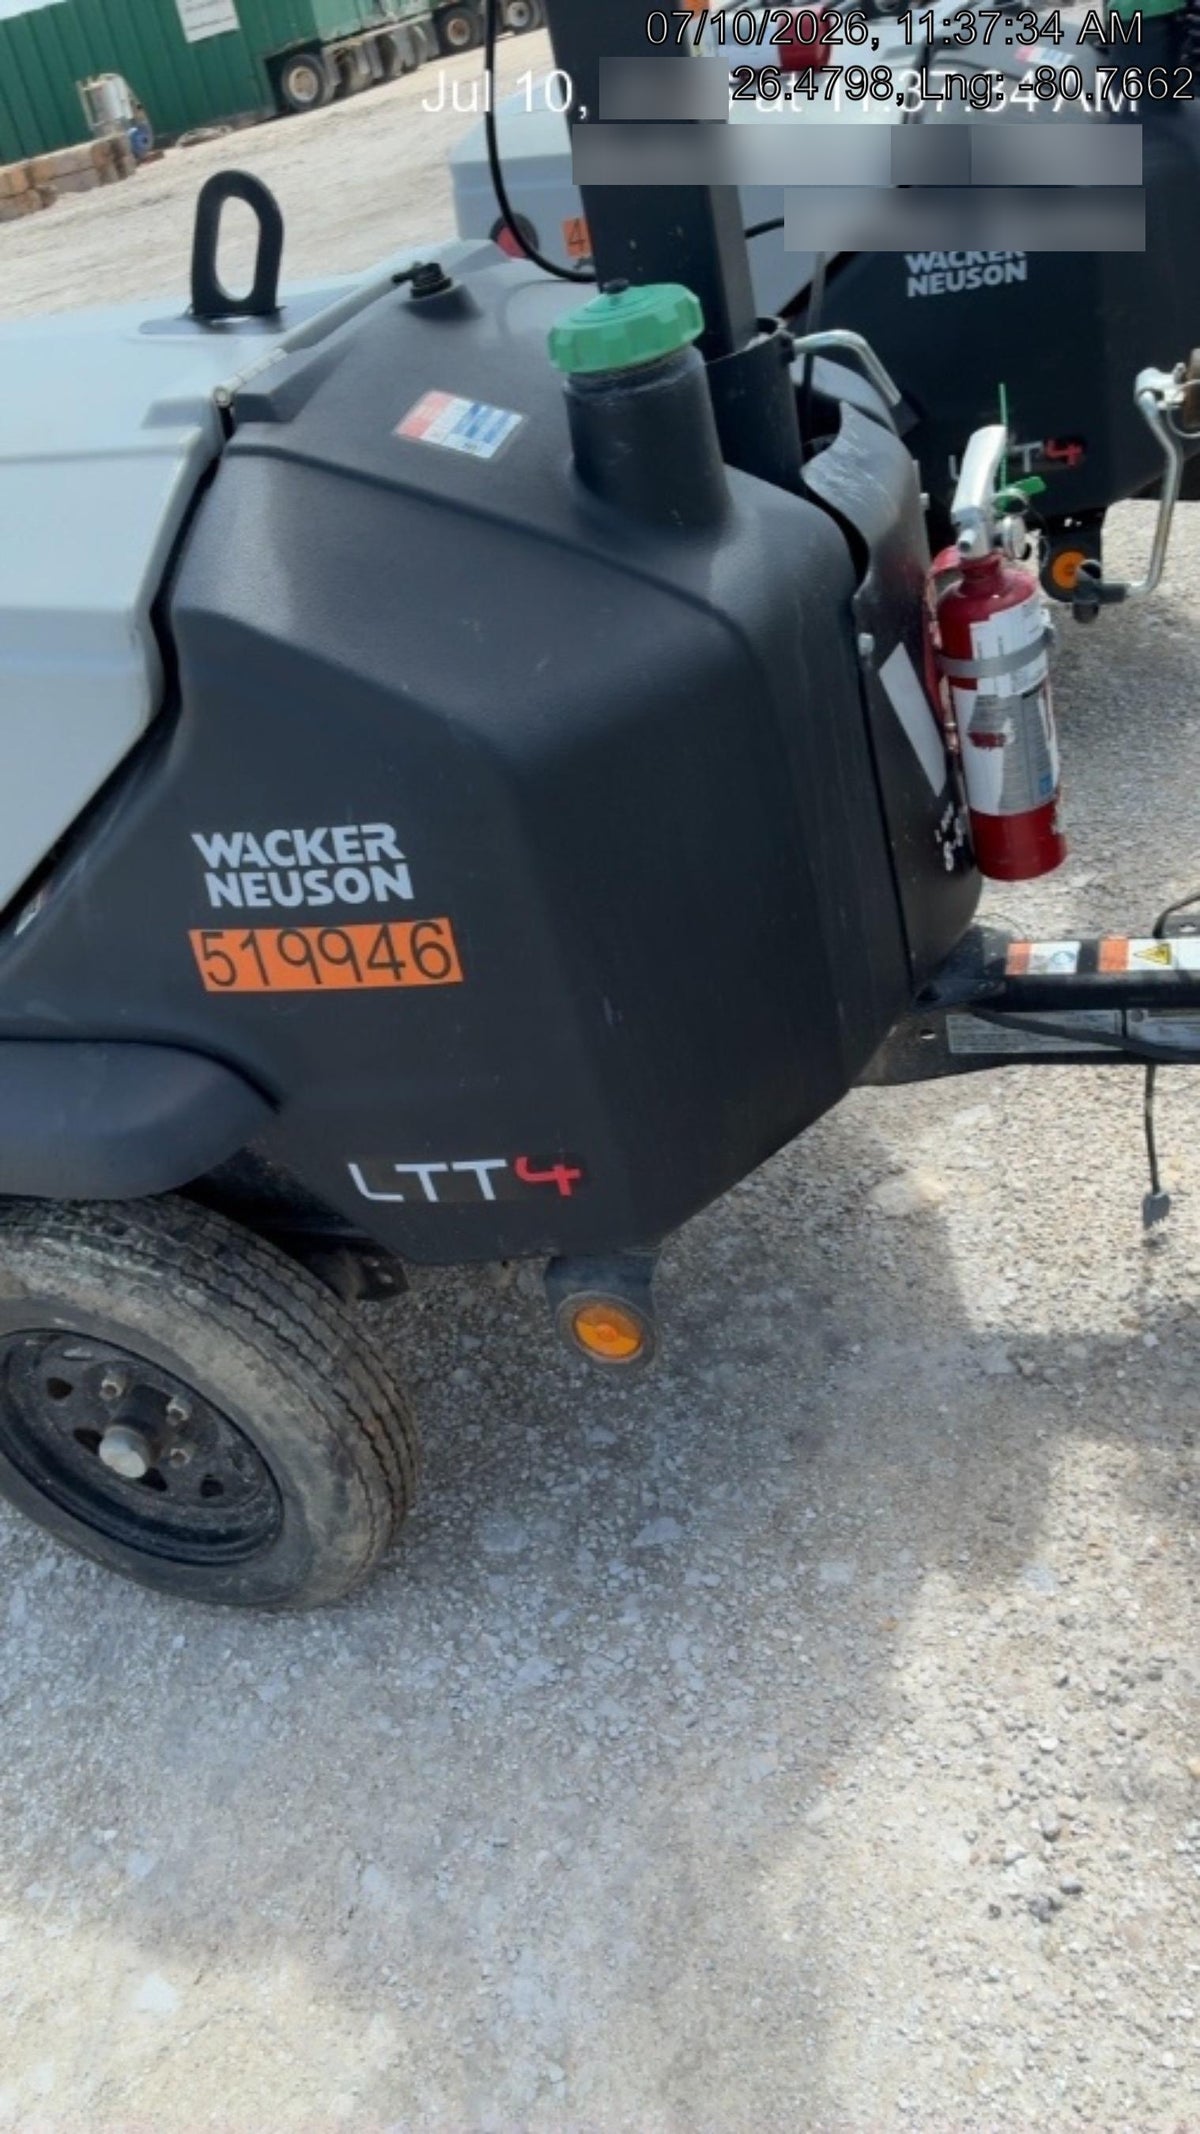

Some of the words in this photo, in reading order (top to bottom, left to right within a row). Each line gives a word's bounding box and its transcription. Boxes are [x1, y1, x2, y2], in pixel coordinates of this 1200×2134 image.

[907, 259, 1028, 298] NEUSON
[948, 437, 1084, 482] LT4
[190, 822, 406, 868] WACKER
[203, 862, 415, 907] NEUSON
[199, 920, 452, 988] 519946
[347, 1155, 582, 1203] LTT4
